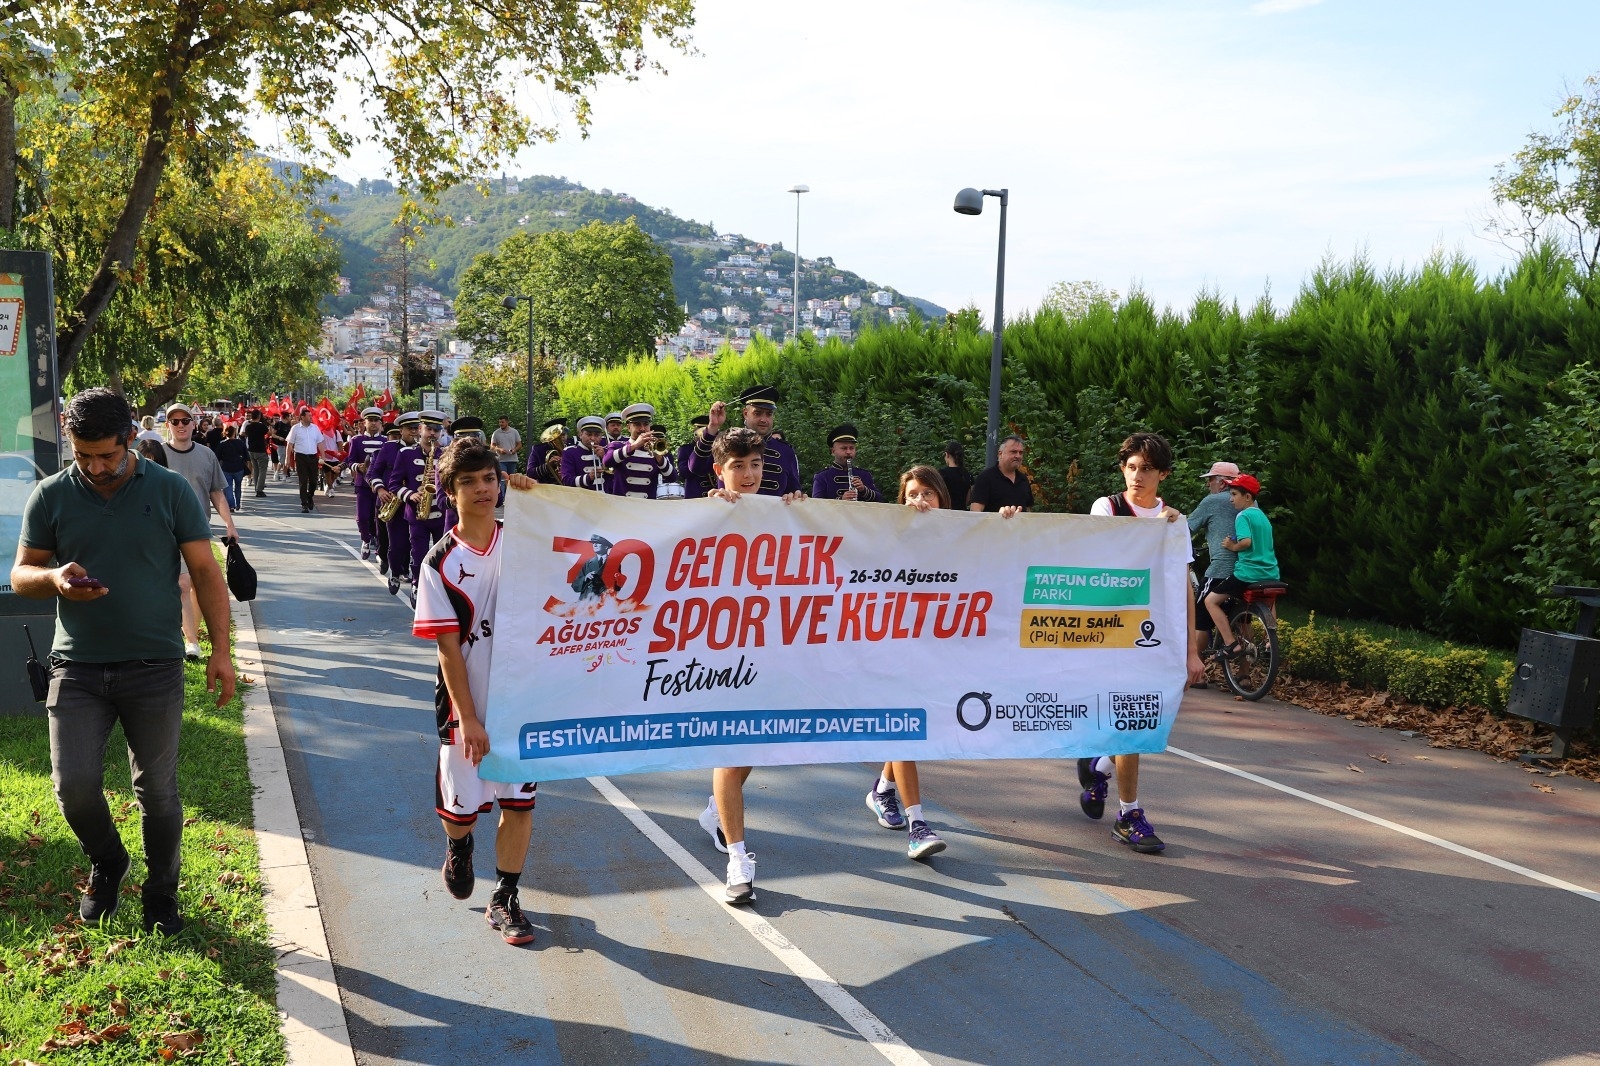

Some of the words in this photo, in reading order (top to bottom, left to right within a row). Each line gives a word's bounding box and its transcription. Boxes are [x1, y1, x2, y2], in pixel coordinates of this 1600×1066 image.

[665, 533, 844, 592] GENÇLİK,
[543, 536, 655, 617] 30
[849, 569, 893, 584] 26-30
[894, 568, 959, 585] Ağustos
[1034, 573, 1087, 587] TAYFUN
[1089, 572, 1145, 588] GÜRSOY
[1032, 588, 1072, 601] PARKI
[647, 596, 771, 653] SPOR
[779, 595, 834, 646] VE
[837, 591, 993, 642] KÜLTÜR
[1030, 616, 1081, 629] AKYAZI
[1086, 614, 1125, 629] SAHİL
[536, 617, 642, 645] AĞUSTOS
[1029, 630, 1059, 645] (Plaj
[1062, 631, 1105, 644] Mevki)
[549, 644, 584, 657] ZAFER
[584, 638, 628, 652] BAYRAMI
[643, 655, 758, 701] Festivali
[1026, 692, 1058, 703] ORDU
[995, 704, 1088, 720] BÜYÜKŞEHİR
[1112, 701, 1160, 711] ÜRETEN
[526, 719, 673, 750] FESTİVALİMİZE
[677, 716, 718, 738] TÜM
[722, 718, 812, 737] HALKIMIZ
[815, 712, 921, 734] DAVETLİDİR
[1012, 720, 1073, 732] BELEDİYESİ
[1114, 718, 1158, 731] ORDU
